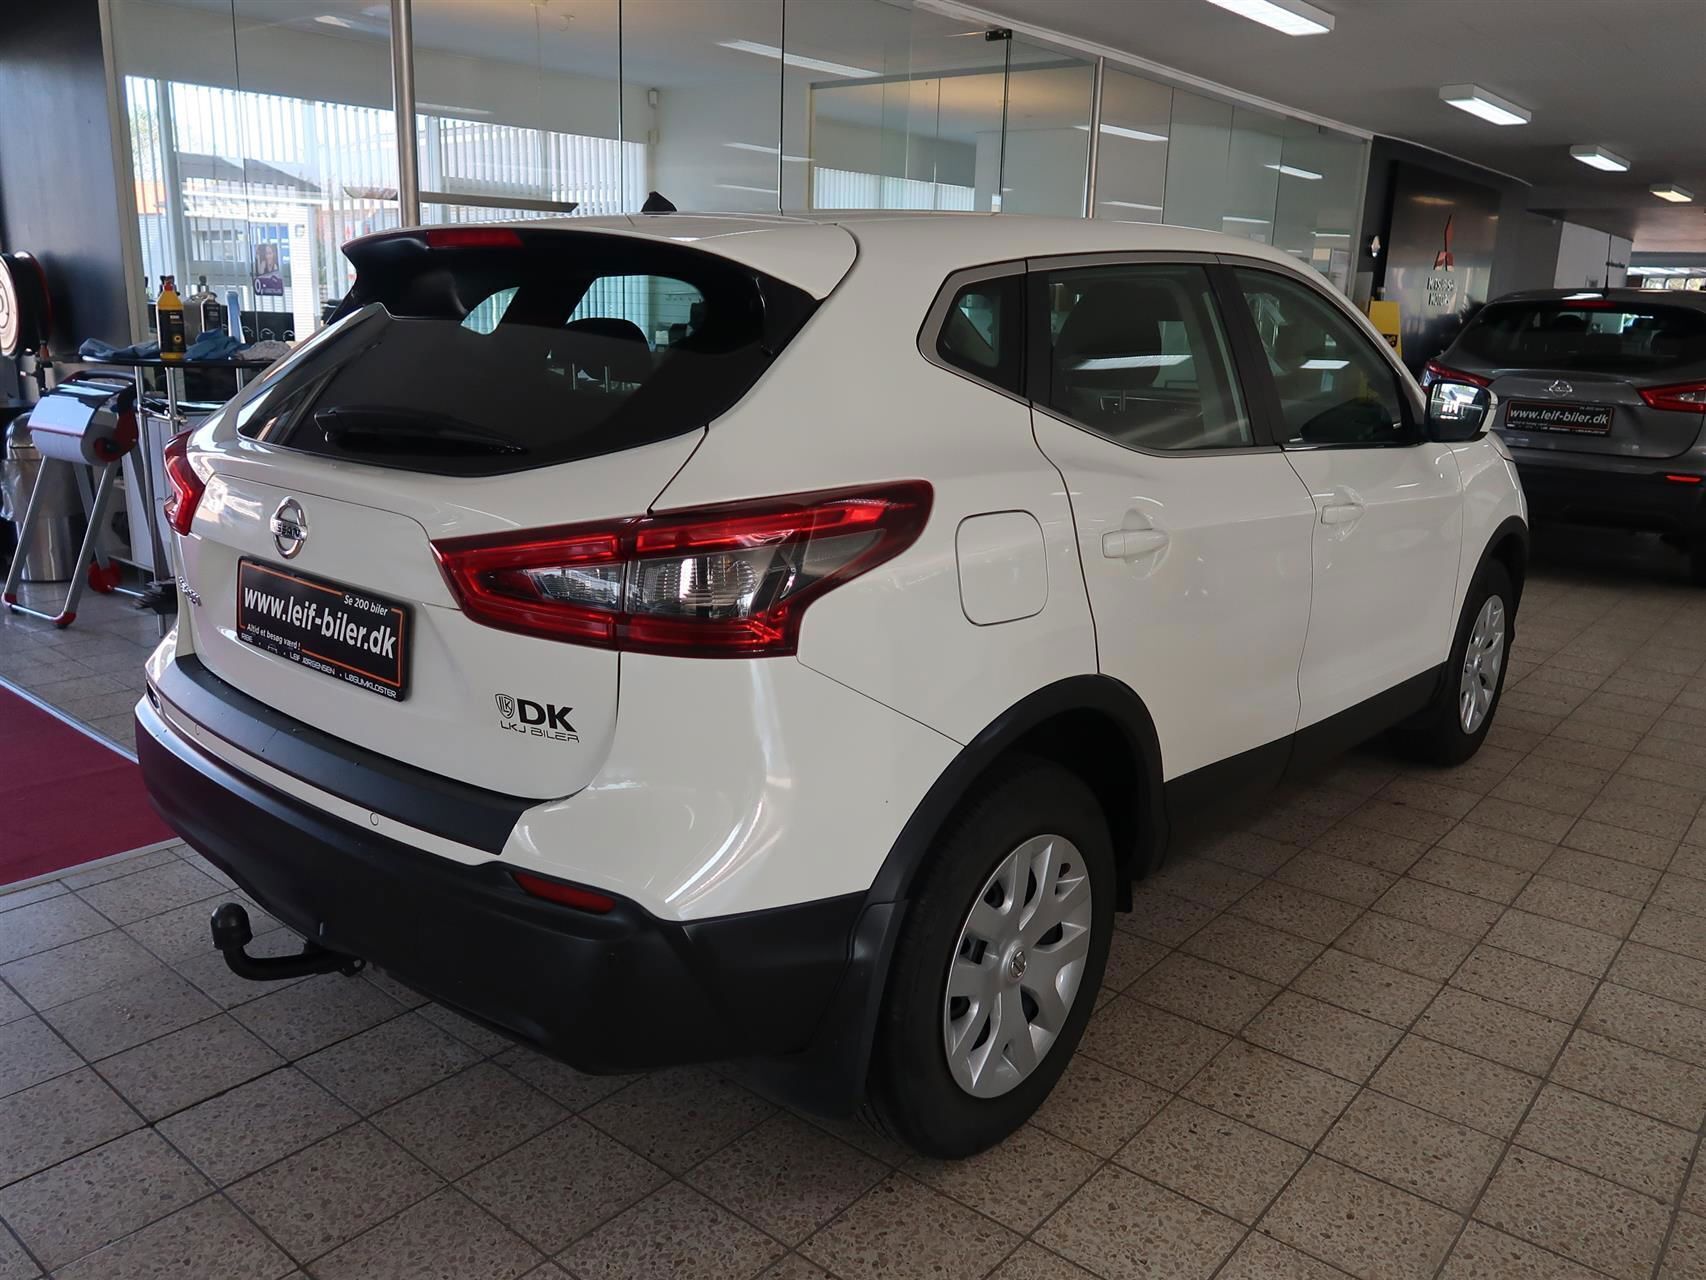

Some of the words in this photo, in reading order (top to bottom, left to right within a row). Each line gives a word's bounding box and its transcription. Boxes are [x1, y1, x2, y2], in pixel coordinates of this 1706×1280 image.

[1510, 408, 1609, 425] www.leif-biler.dk
[343, 594, 353, 606] Se
[353, 598, 370, 610] 200
[370, 602, 388, 616] biler
[244, 586, 397, 659] www.leif-biler.dk
[260, 629, 266, 637] et
[266, 629, 283, 645] besøg
[516, 698, 577, 733] DK
[500, 720, 526, 733] LKJ
[530, 726, 580, 743] BILER
